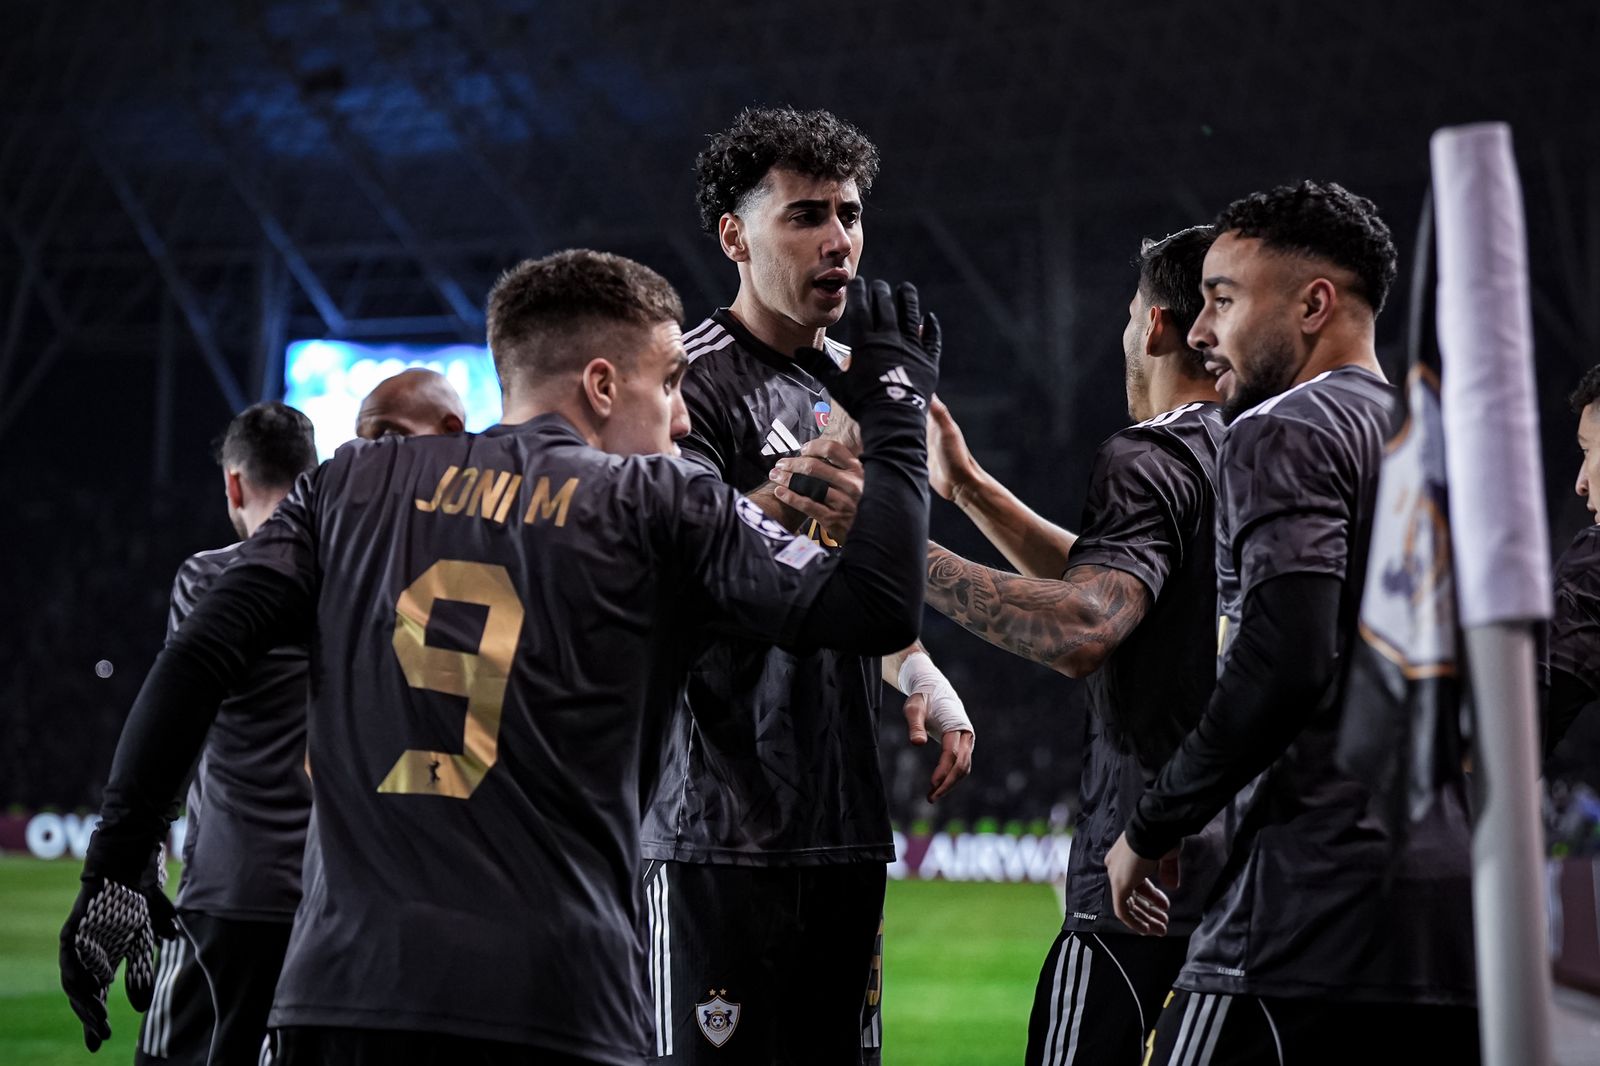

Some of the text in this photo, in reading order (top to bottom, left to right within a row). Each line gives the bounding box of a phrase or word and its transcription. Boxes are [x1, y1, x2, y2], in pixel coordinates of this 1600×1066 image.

[415, 466, 579, 527] JONI M
[376, 559, 525, 799] 9
[918, 832, 1072, 882] AIRWA
